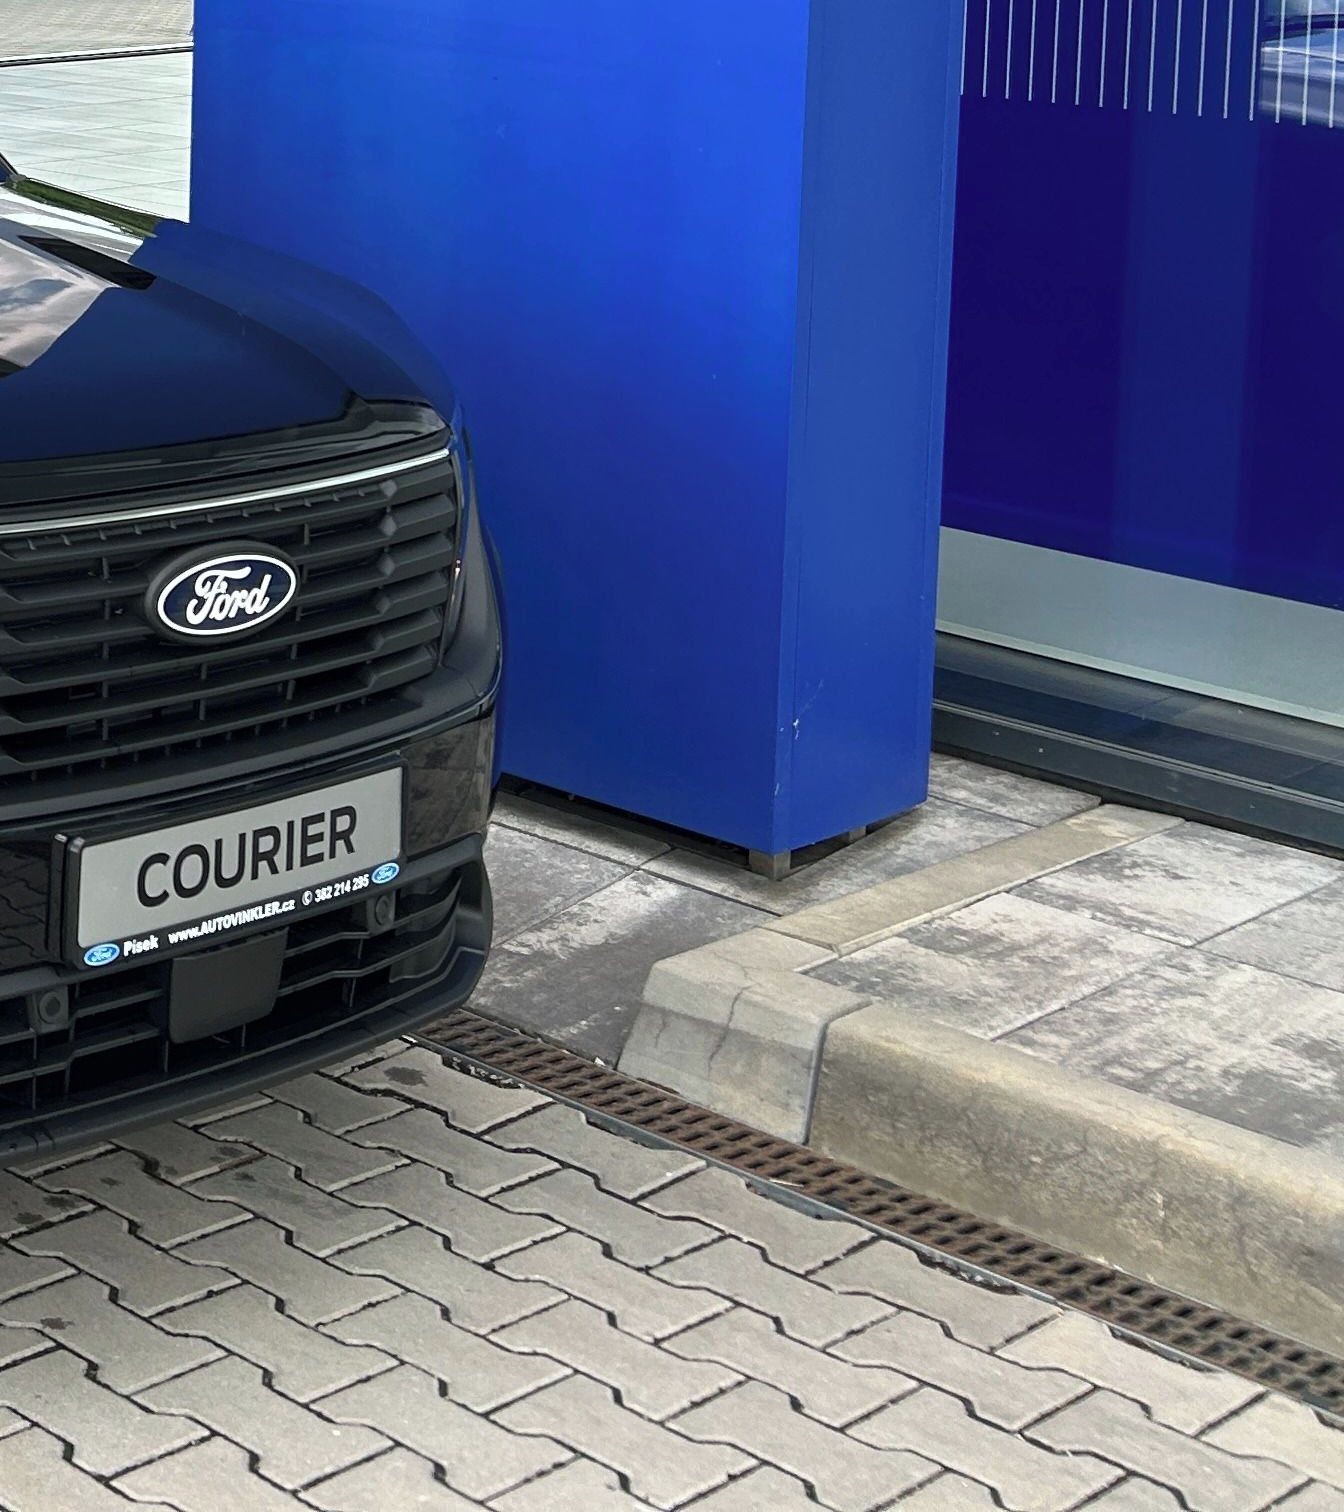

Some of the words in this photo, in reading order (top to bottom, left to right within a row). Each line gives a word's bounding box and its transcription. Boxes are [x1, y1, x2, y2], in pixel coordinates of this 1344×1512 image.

[184, 563, 274, 627] Ford
[136, 804, 358, 909] COURIER
[168, 899, 296, 944] www.AUTOVINKLER.cz
[333, 880, 352, 897] 214
